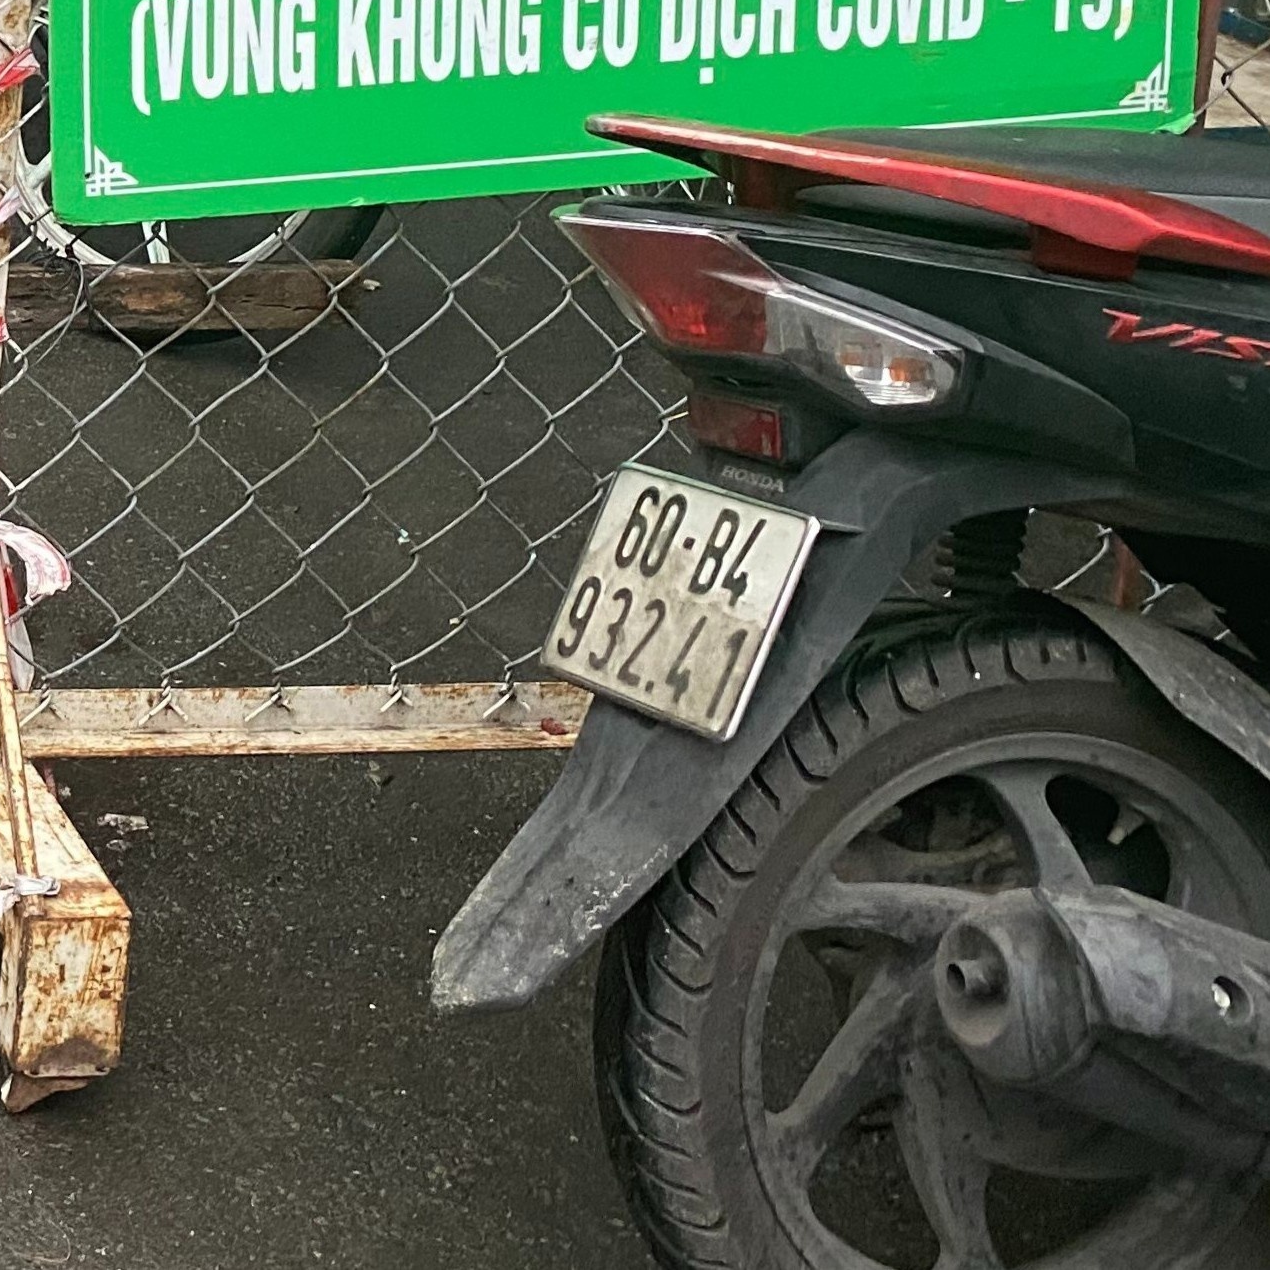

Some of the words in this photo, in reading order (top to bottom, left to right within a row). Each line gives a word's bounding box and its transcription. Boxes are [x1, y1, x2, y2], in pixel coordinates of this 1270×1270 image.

[1102, 307, 1270, 367] VIS
[722, 465, 784, 493] HONDA
[615, 486, 767, 609] 60-B4
[557, 576, 748, 720] 932.41
